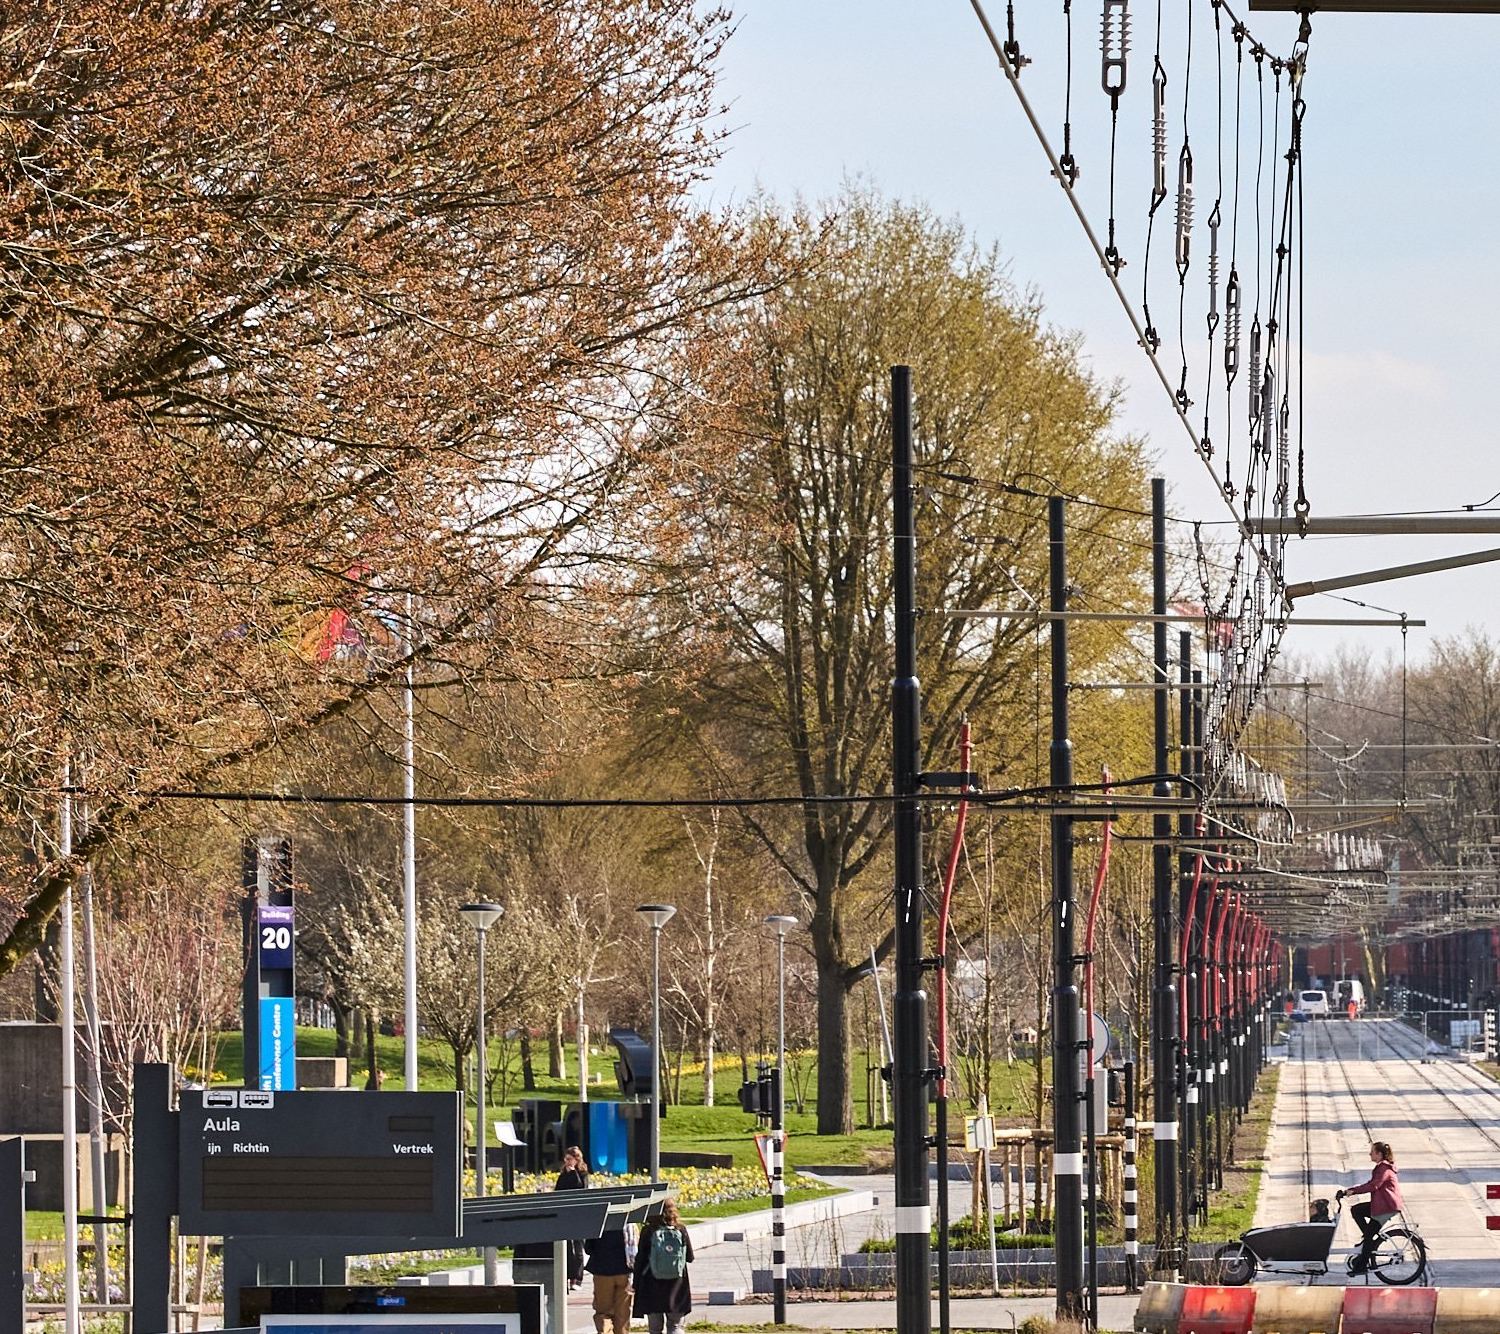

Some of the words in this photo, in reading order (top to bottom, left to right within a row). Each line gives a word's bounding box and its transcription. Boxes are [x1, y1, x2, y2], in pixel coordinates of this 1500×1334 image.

[262, 910, 291, 920] Building
[262, 926, 291, 950] 20
[273, 1039, 281, 1091] onference
[203, 1117, 241, 1132] Aula
[208, 1142, 221, 1155] ijn
[233, 1142, 270, 1154] Richtin
[393, 1143, 434, 1155] Vertrek
